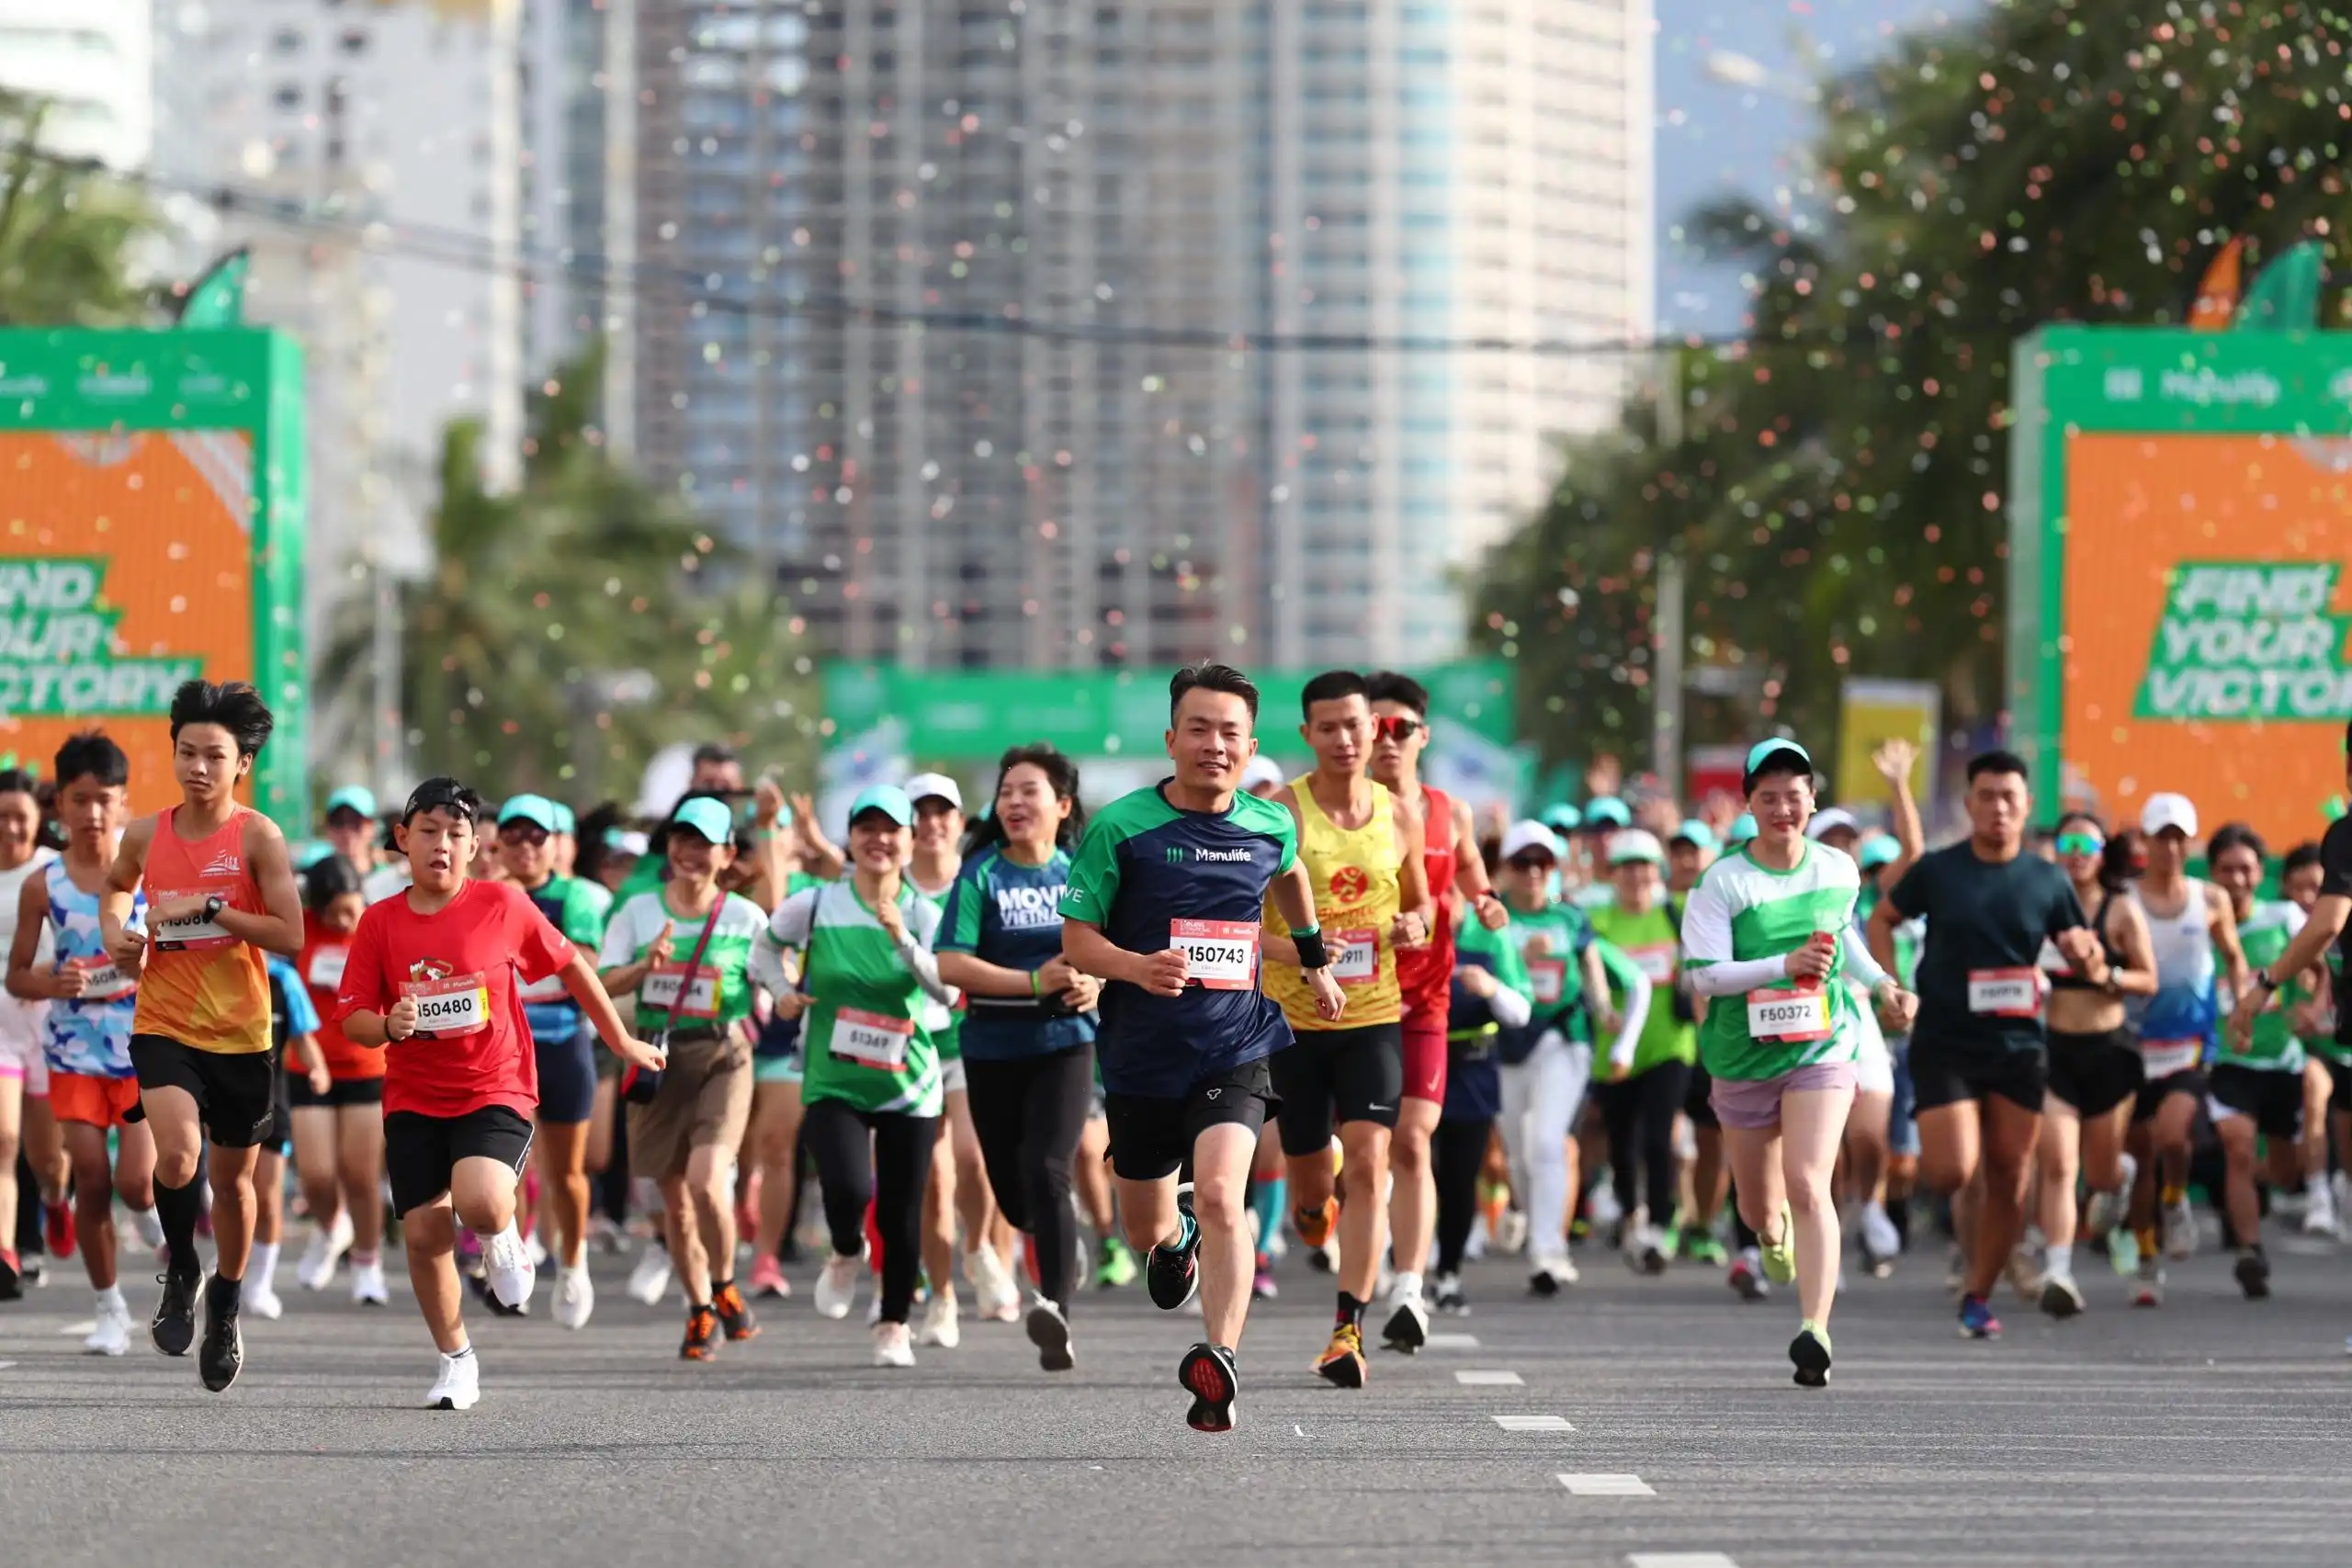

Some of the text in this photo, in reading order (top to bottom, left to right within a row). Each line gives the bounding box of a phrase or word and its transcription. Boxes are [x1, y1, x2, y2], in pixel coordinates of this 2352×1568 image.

[2175, 566, 2328, 614] FIND
[2165, 616, 2335, 663] YOUR
[1195, 848, 1251, 862] Manulife
[1759, 1004, 1811, 1023] F50372
